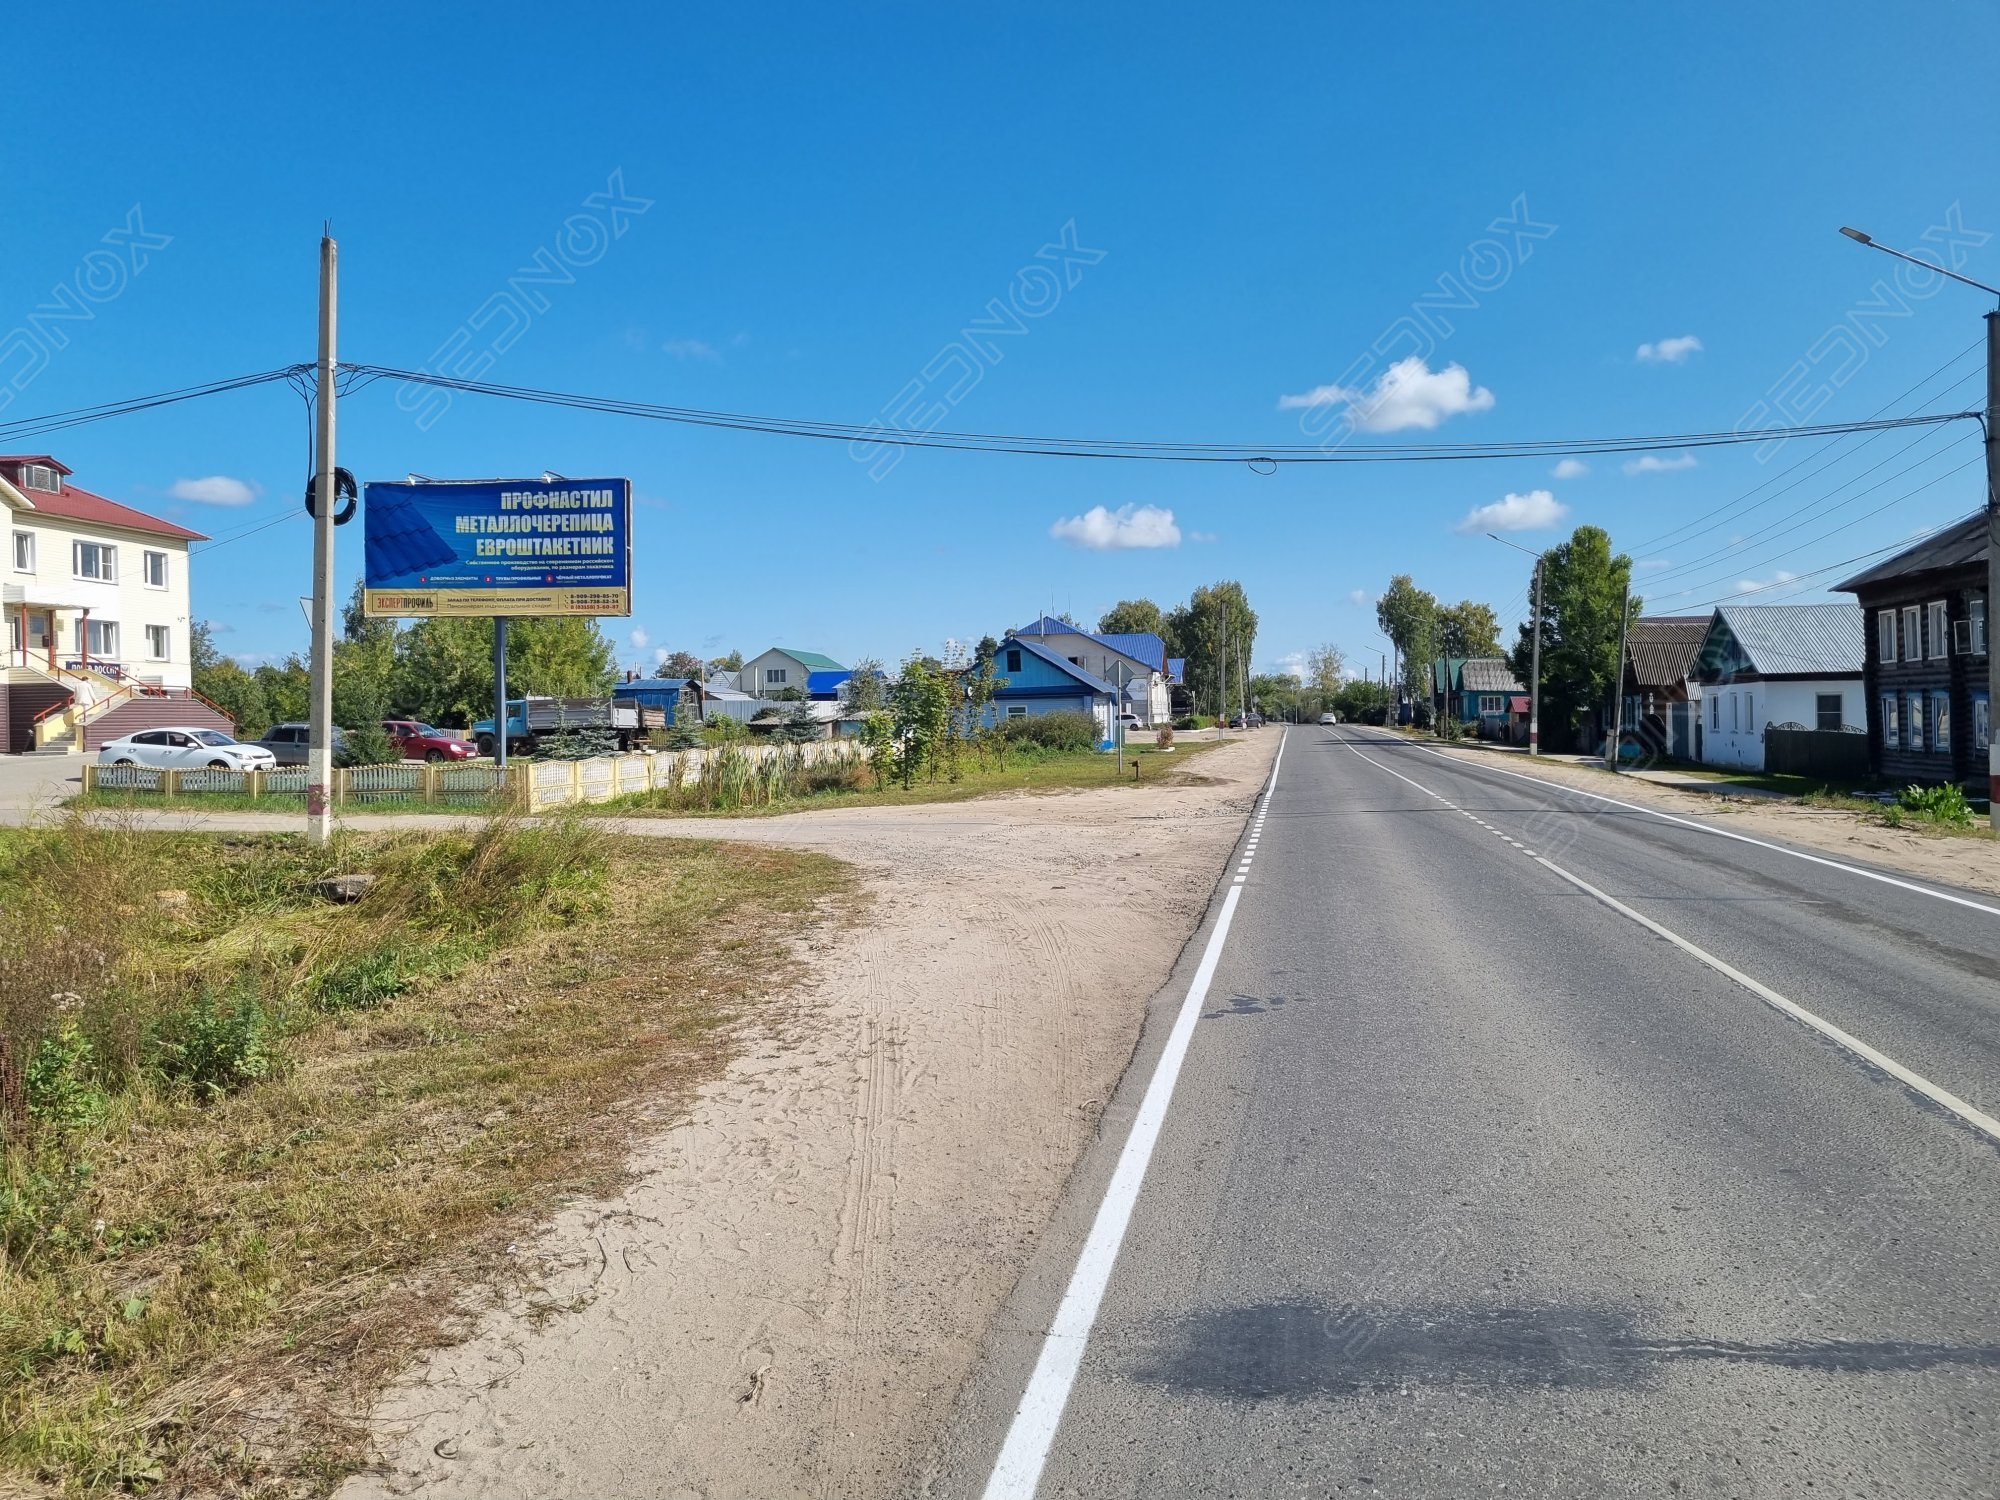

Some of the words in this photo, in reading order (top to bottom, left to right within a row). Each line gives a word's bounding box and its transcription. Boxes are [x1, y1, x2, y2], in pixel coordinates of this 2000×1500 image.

[501, 489, 613, 510] ПРОФНАСТИЛ
[455, 513, 614, 534] МЕТАЛЛОЧЕРЕПИЦА
[476, 537, 614, 557] ЕВРОШТАКЕТНИК
[377, 597, 434, 609] ЭКСПЕРТПРОФИЛЬ
